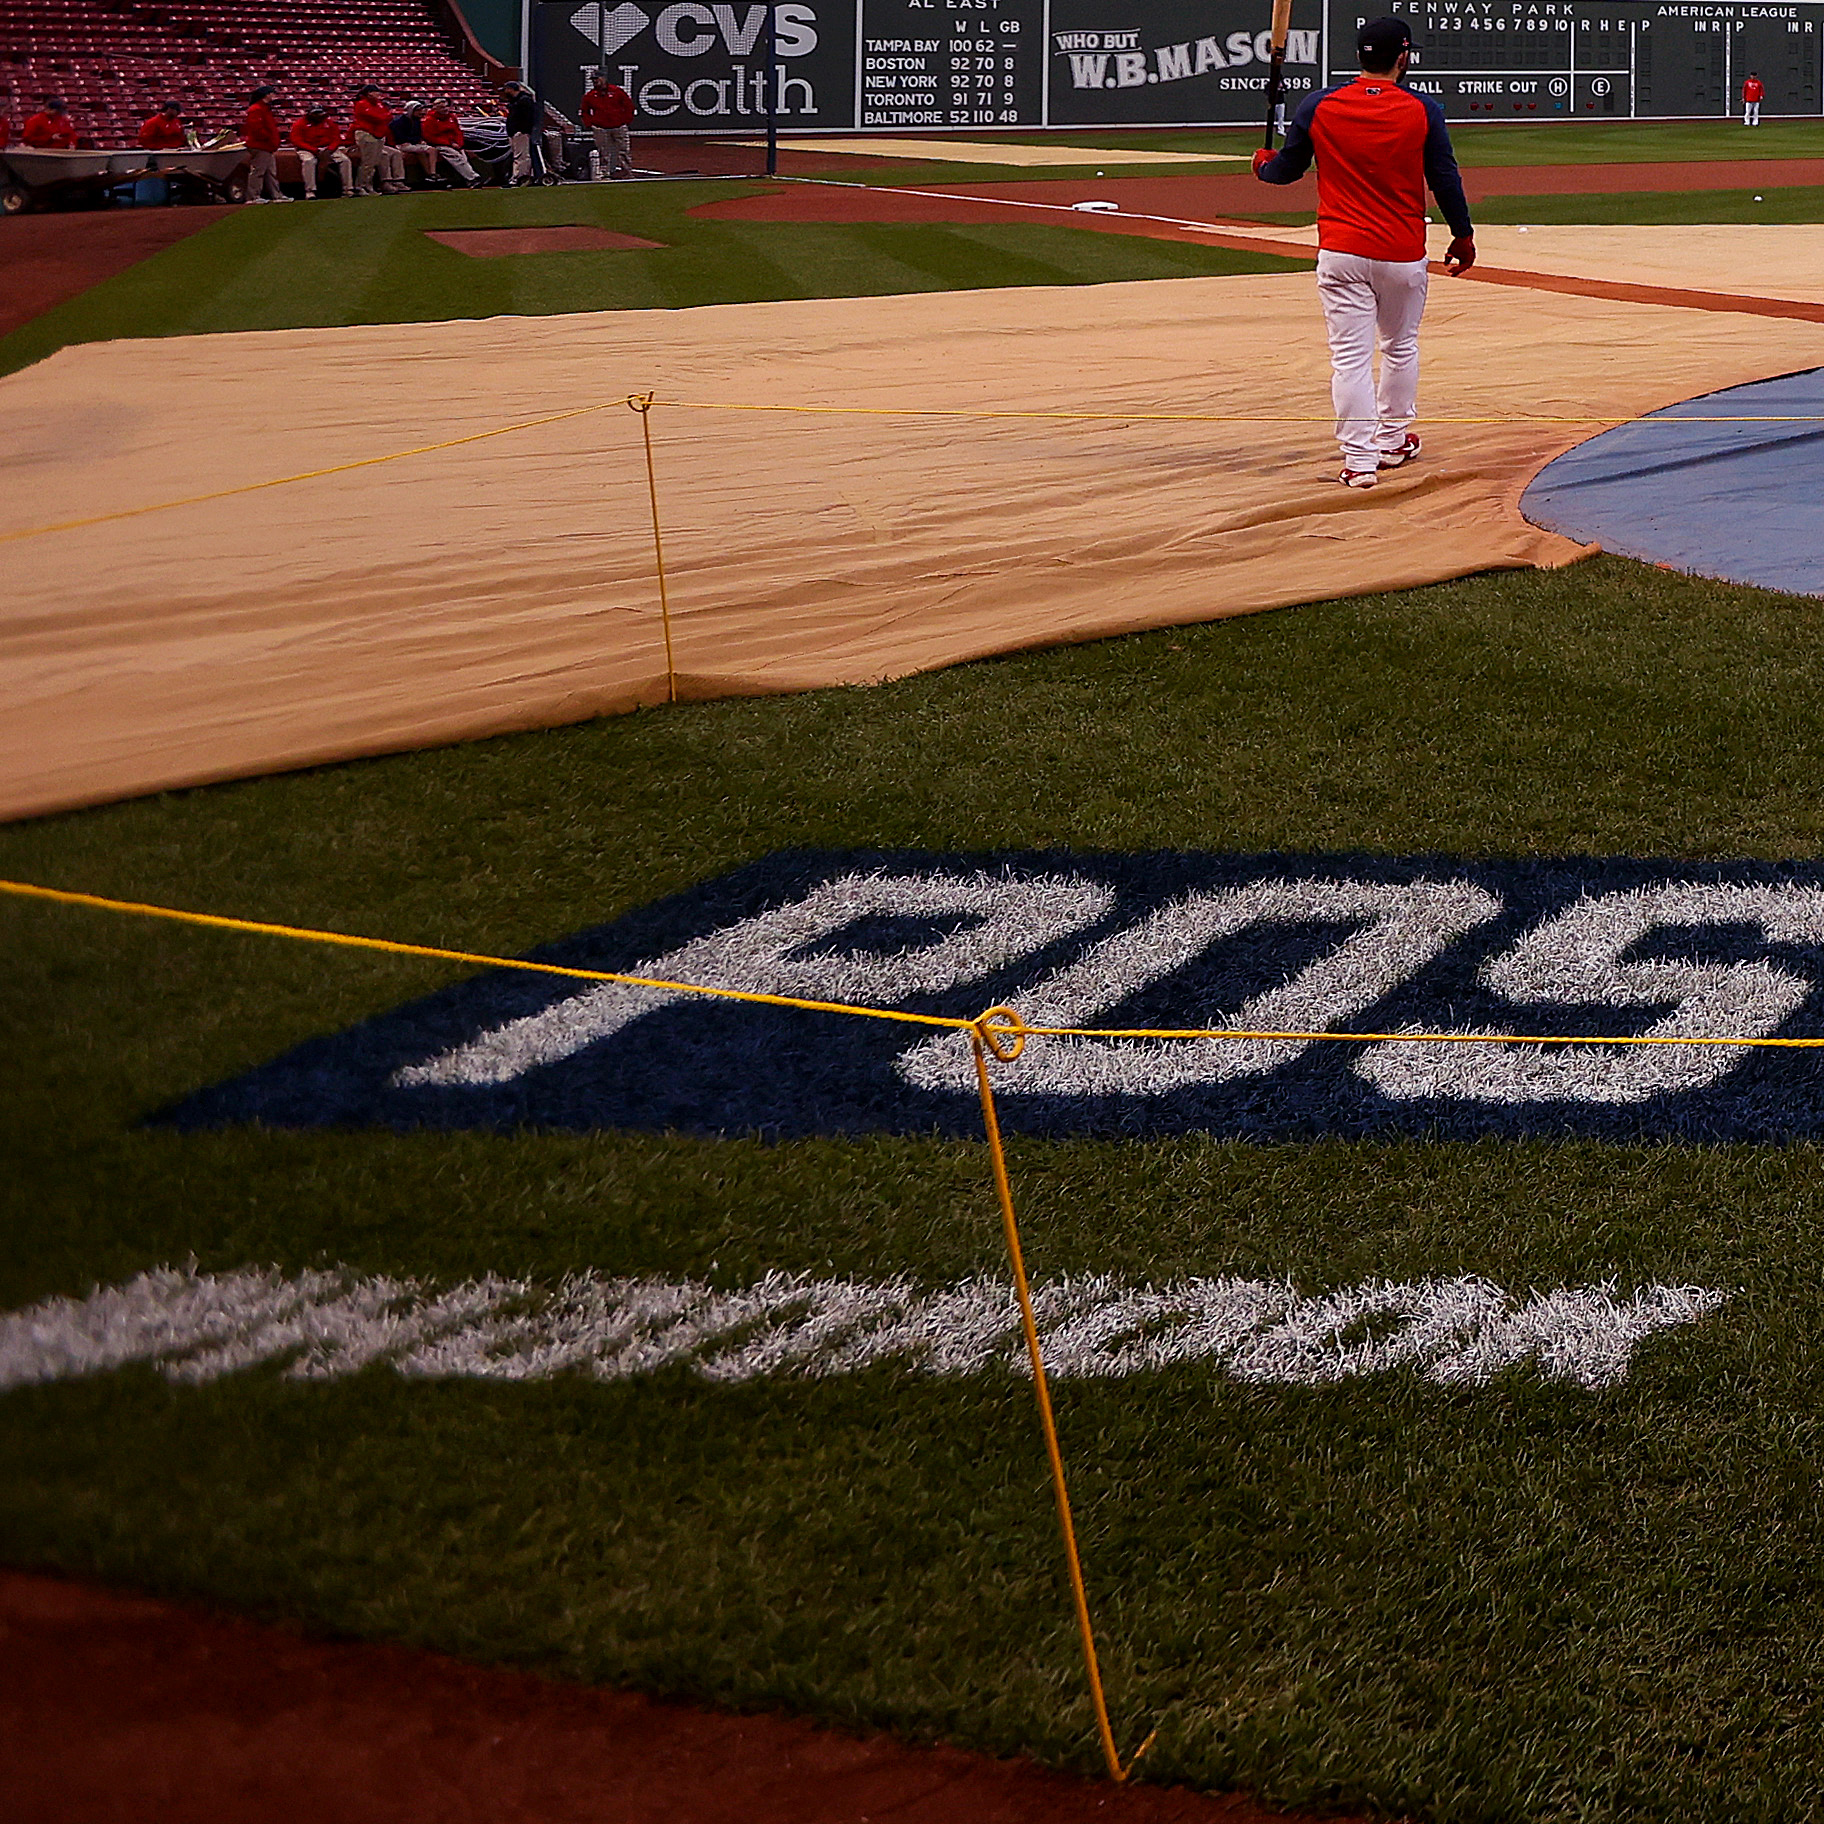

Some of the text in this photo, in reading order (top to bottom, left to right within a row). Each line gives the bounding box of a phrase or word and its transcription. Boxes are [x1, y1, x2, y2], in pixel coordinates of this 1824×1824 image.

[1393, 2, 1574, 15] FENWAY PARK
[1657, 6, 1797, 17] AMERICAN LEAGUE
[655, 2, 818, 57] CVS
[955, 21, 1020, 33] W L GB
[1428, 18, 1626, 31] 1 2 3 4 5 6 7 8 9 10 R H E
[1642, 21, 1744, 32] P IN R P
[865, 40, 994, 52] TAMPA BAY 100 62
[1055, 33, 1138, 50] WHO BUT
[866, 58, 1014, 70] BOSTON 92 70 8
[865, 76, 1014, 88] NEW YORK 92 70 8
[1458, 81, 1503, 94] STRIKE
[1509, 81, 1537, 94] OUT
[865, 94, 1014, 106] TORONTO 91 71 9
[864, 111, 1018, 124] BALTIMORE 52 110 48
